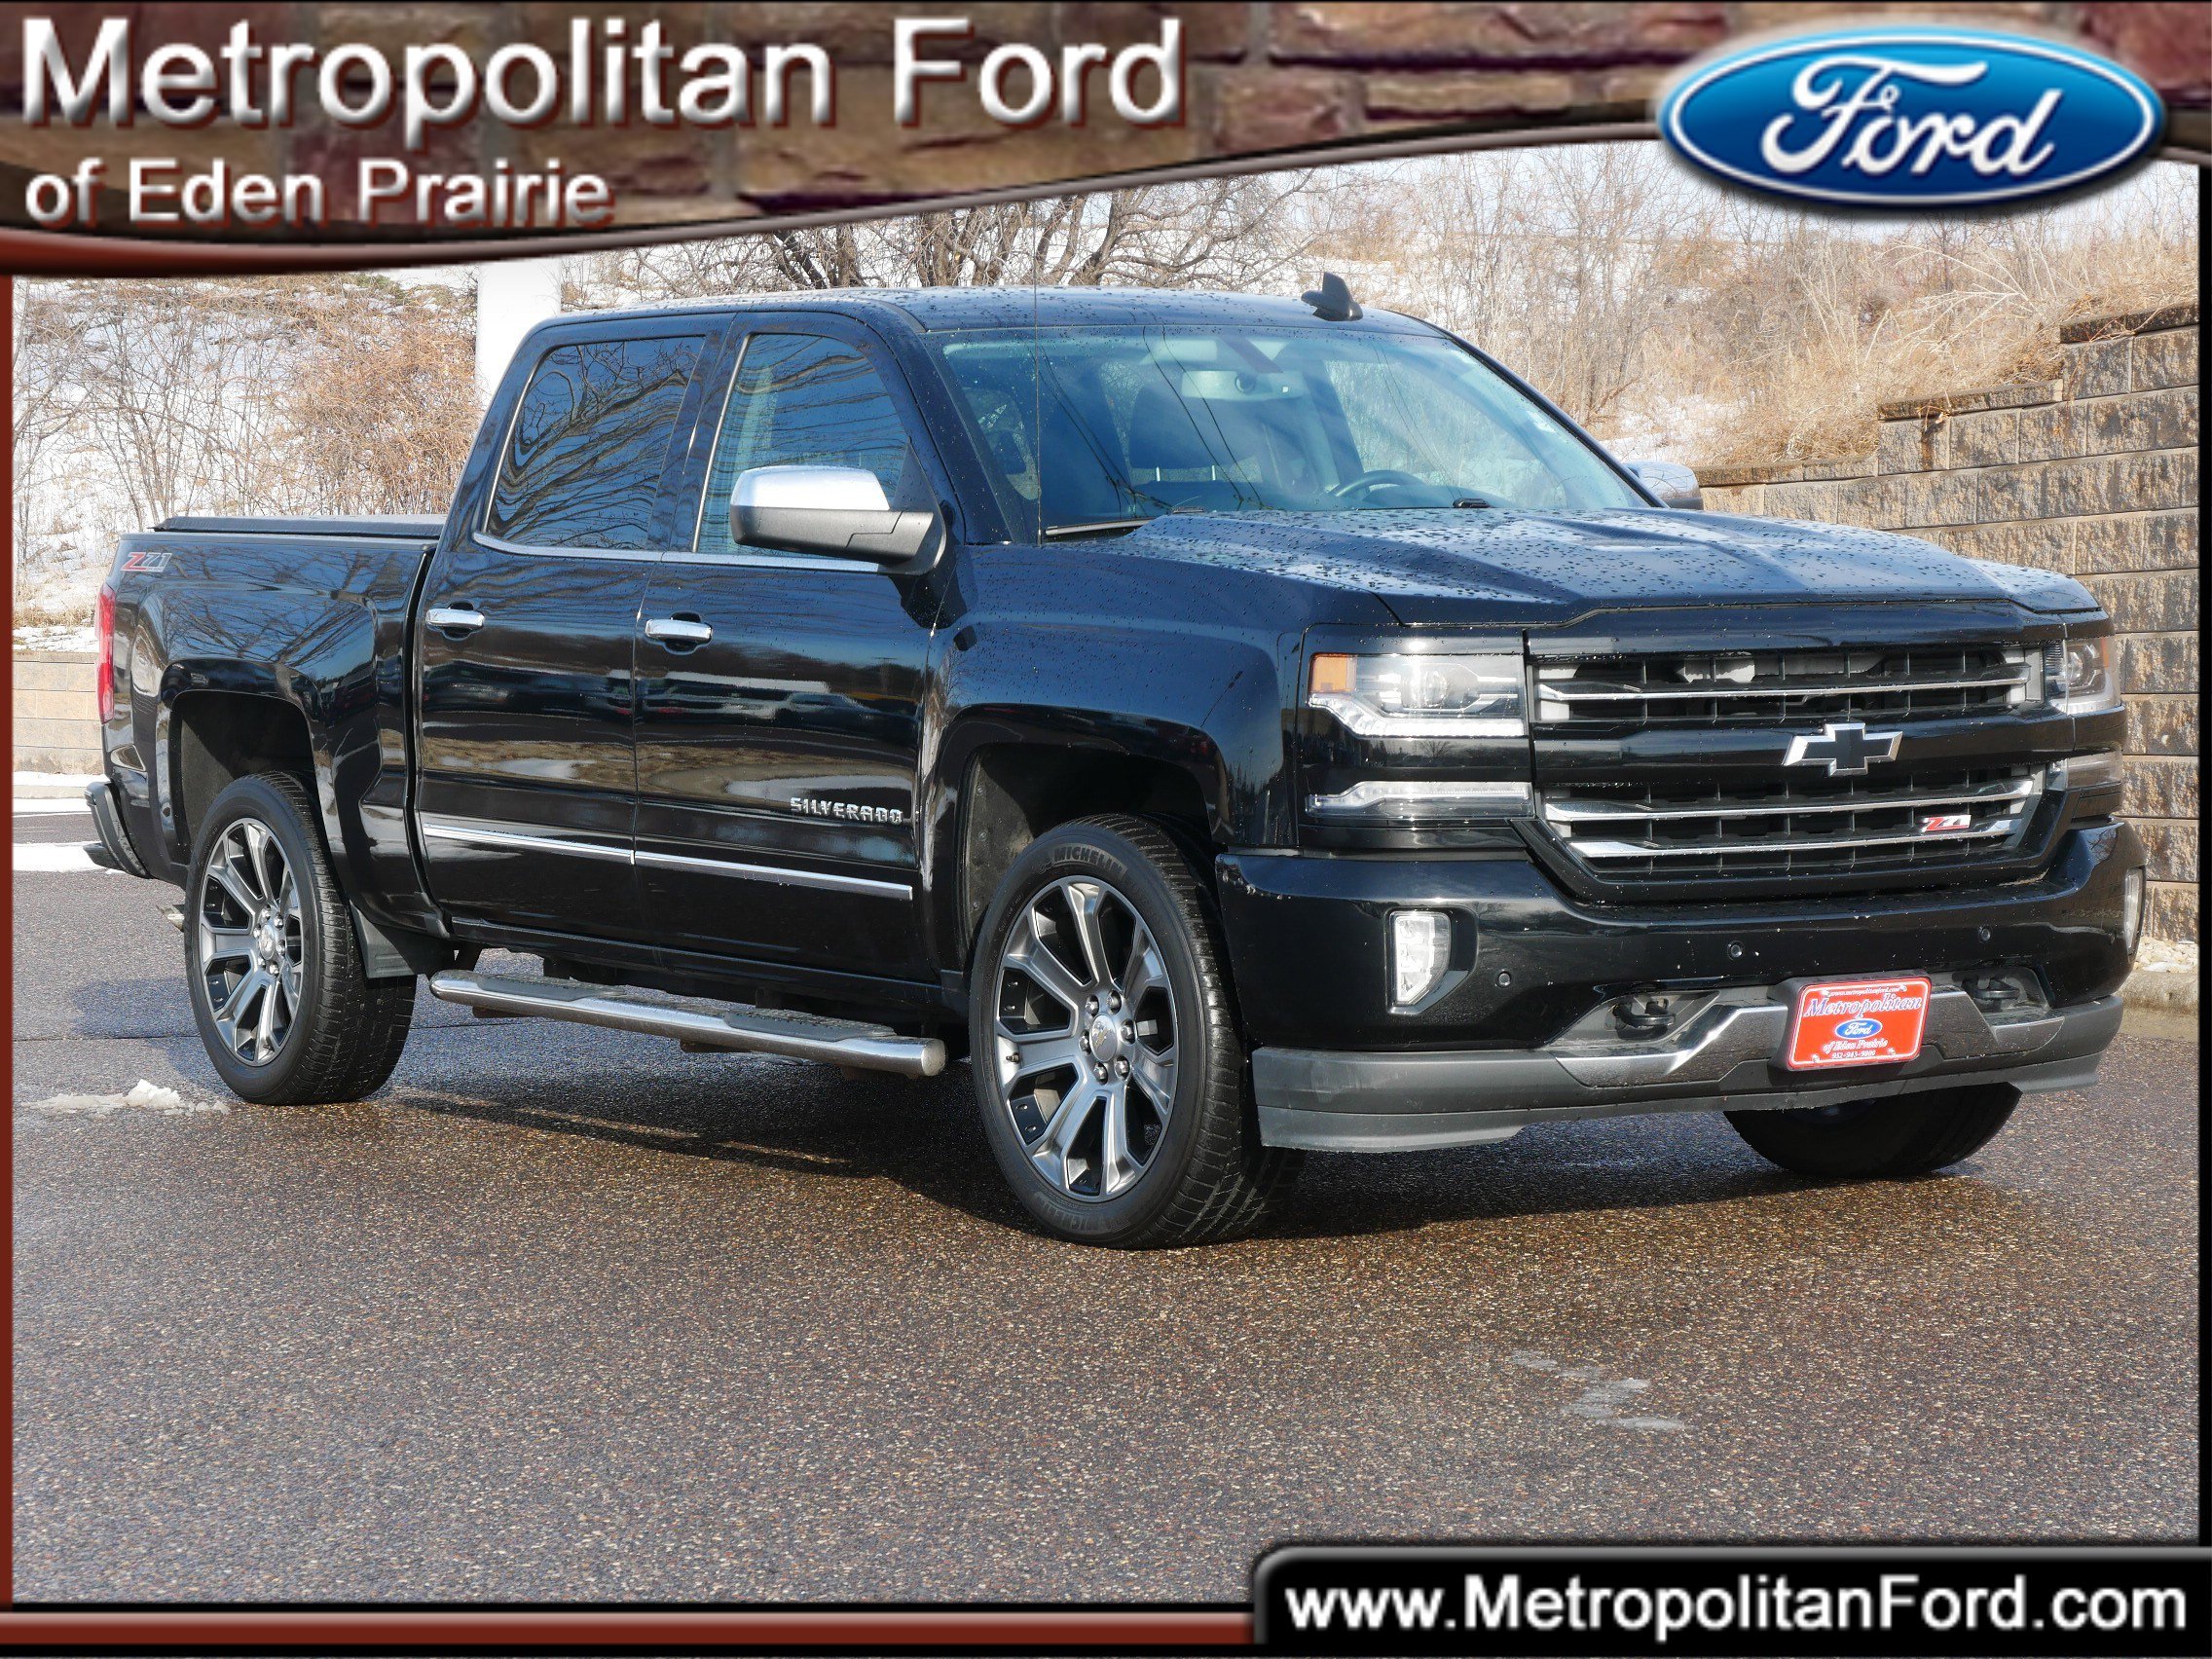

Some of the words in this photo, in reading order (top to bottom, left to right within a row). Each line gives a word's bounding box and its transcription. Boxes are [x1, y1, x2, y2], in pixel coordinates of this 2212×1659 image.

[120, 551, 172, 571] Z71
[790, 796, 903, 825] SILVERADO
[1053, 845, 1124, 874] MICHELIN
[1803, 993, 1922, 1018] Metropolitan
[1844, 1022, 1872, 1036] Ford
